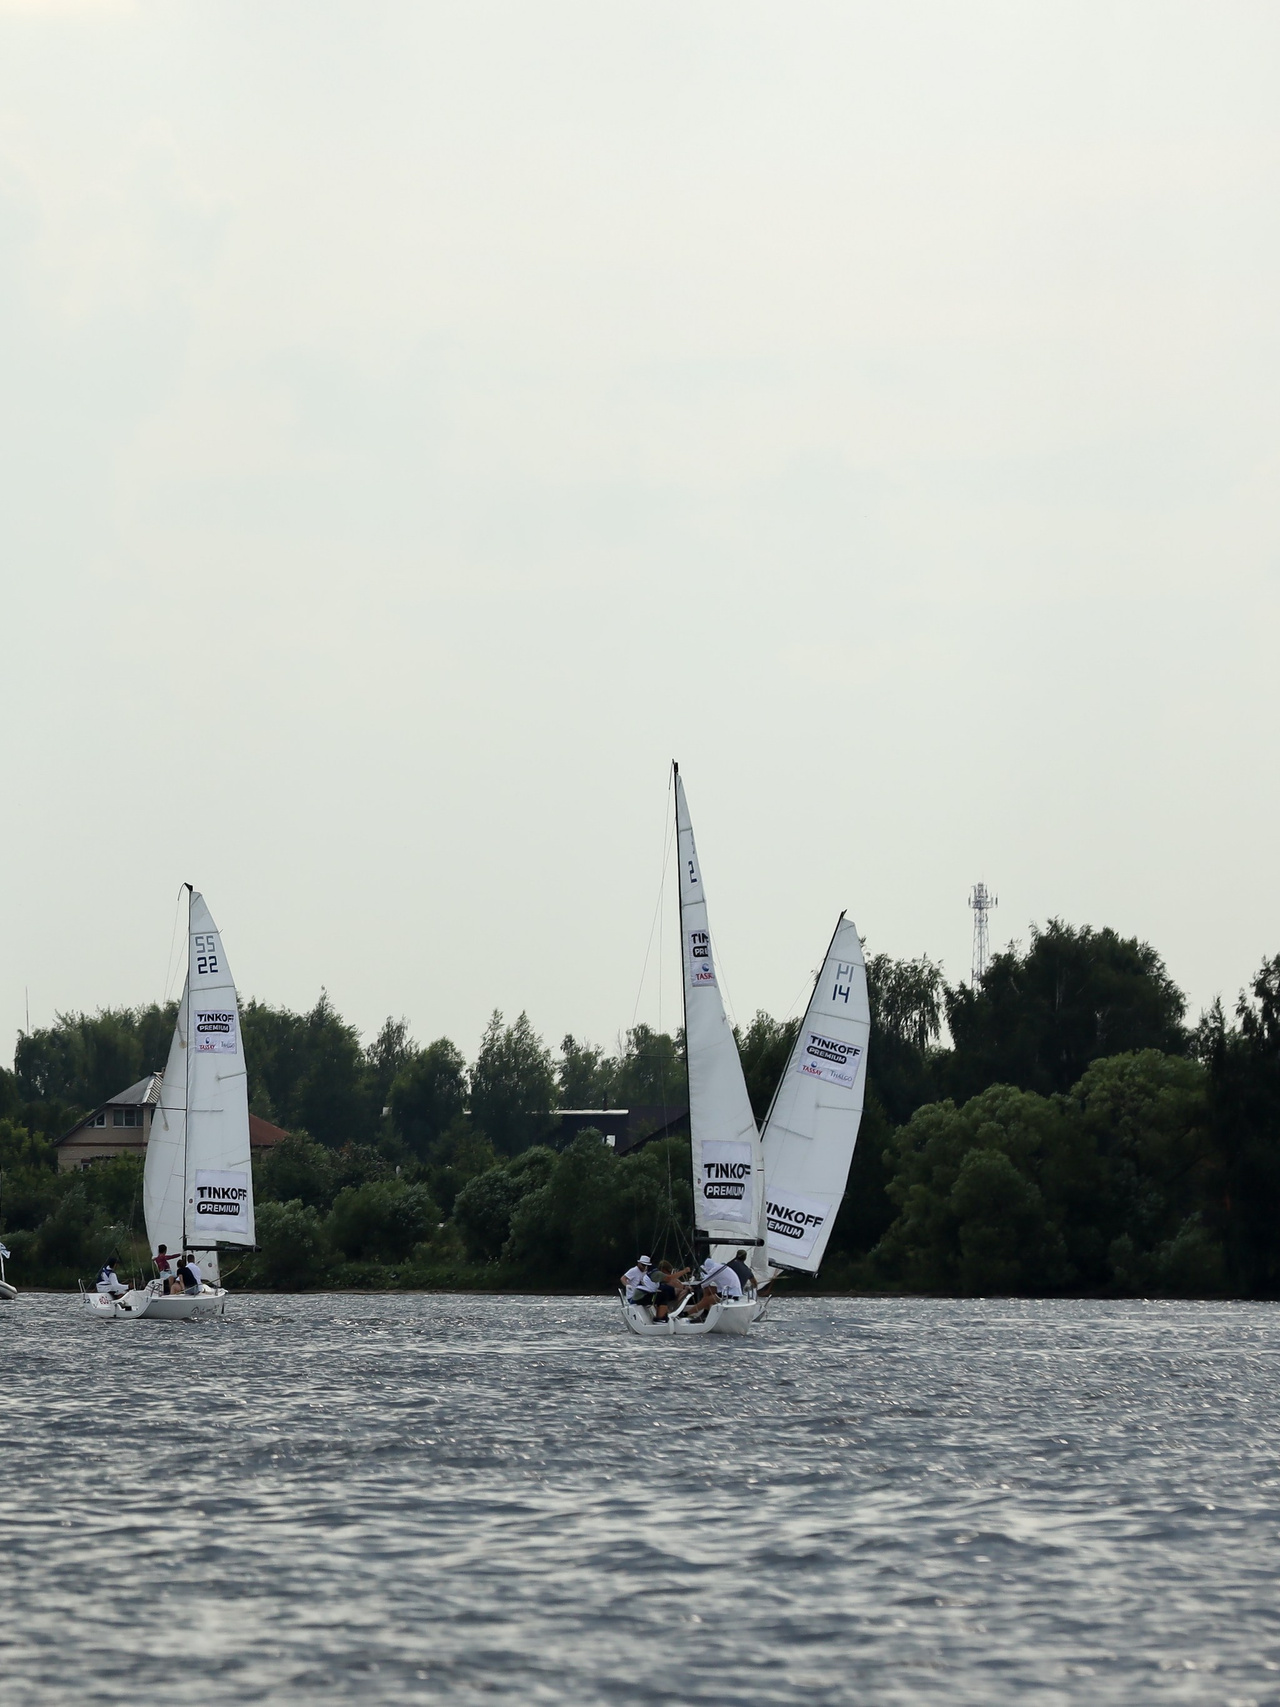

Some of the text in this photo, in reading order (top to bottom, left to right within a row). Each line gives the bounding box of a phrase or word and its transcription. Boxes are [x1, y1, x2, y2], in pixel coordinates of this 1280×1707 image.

[198, 956, 218, 974] 22
[832, 984, 850, 1003] 14
[808, 1047, 846, 1063] PREMIUM
[810, 1035, 860, 1057] TINKOFF
[802, 1065, 822, 1076] TASSAY
[197, 1186, 247, 1200] TINKOFF
[200, 1204, 240, 1214] PREMIUM
[766, 1202, 824, 1228] INKOFF
[767, 1219, 803, 1238] EMIUM
